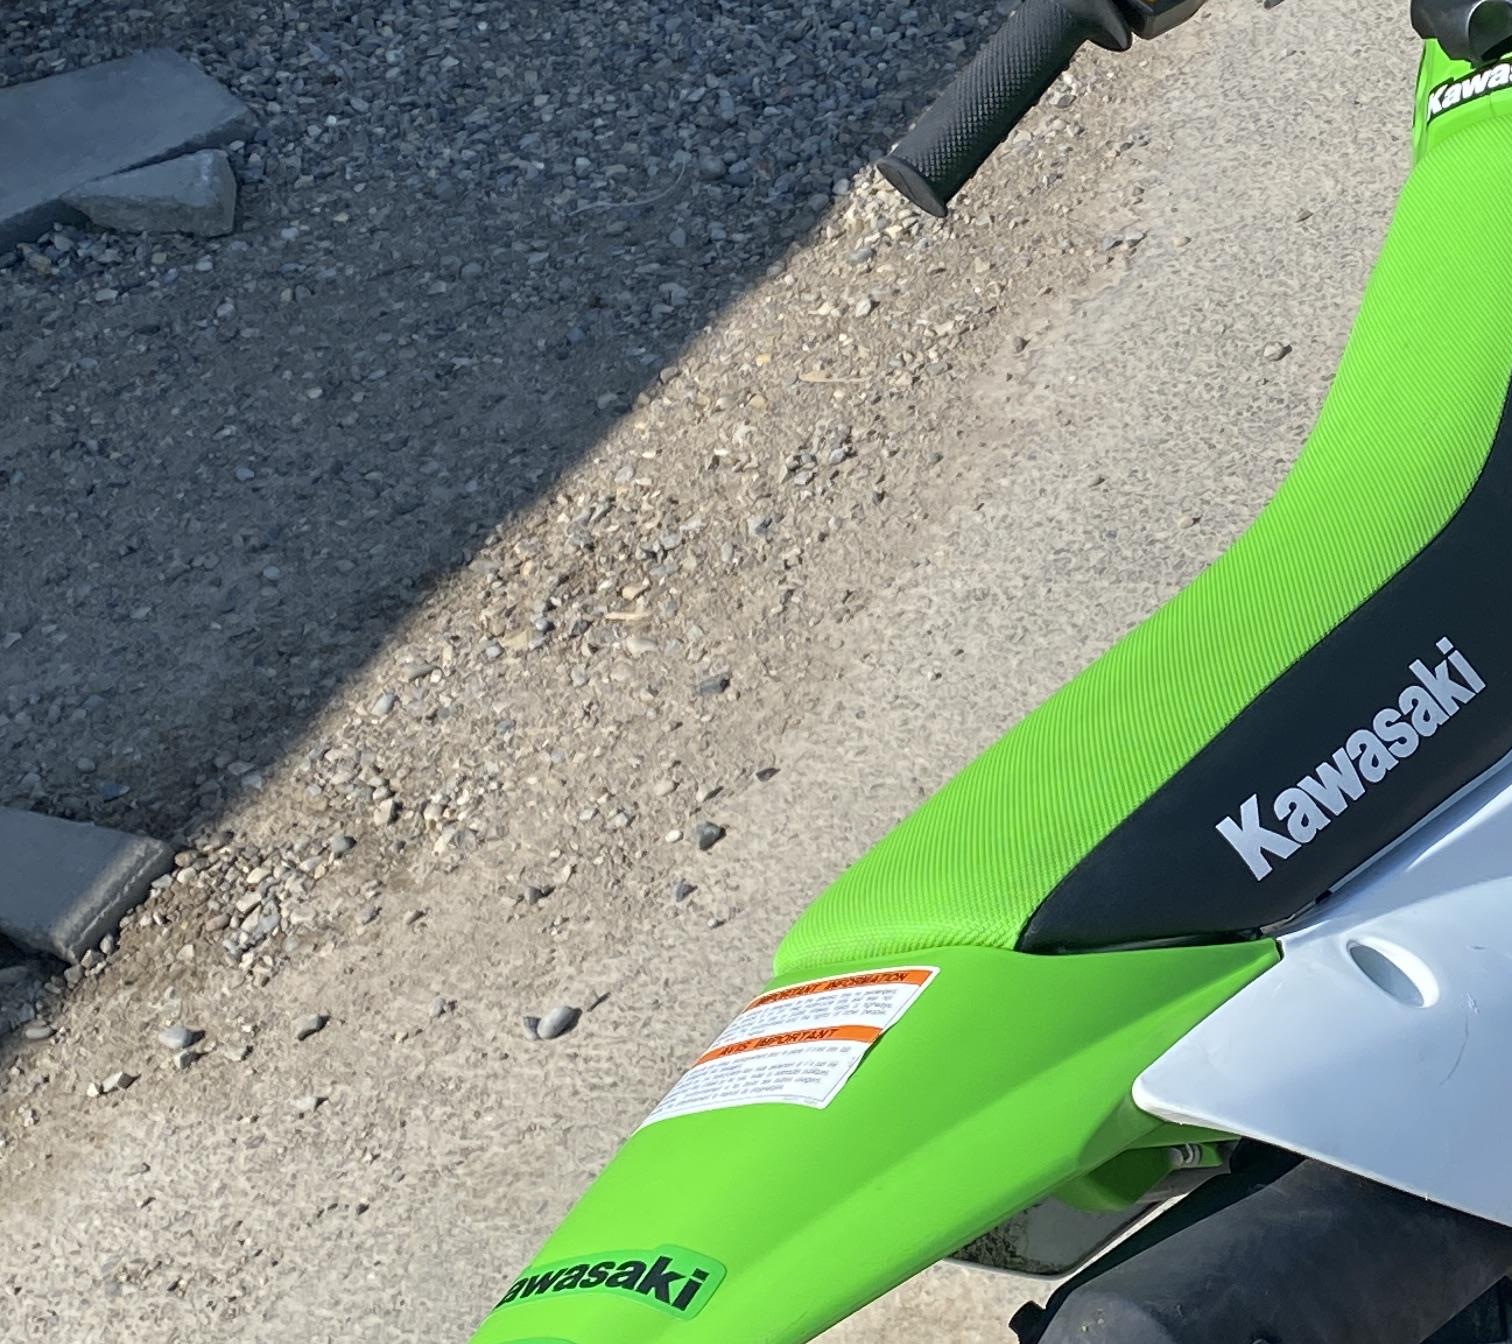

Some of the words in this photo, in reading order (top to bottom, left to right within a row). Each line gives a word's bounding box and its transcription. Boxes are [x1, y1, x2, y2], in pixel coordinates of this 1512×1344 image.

[1216, 637, 1487, 881] Kawasaki
[757, 1028, 839, 1049] IMPORTANT
[495, 1256, 710, 1312] awasaki
